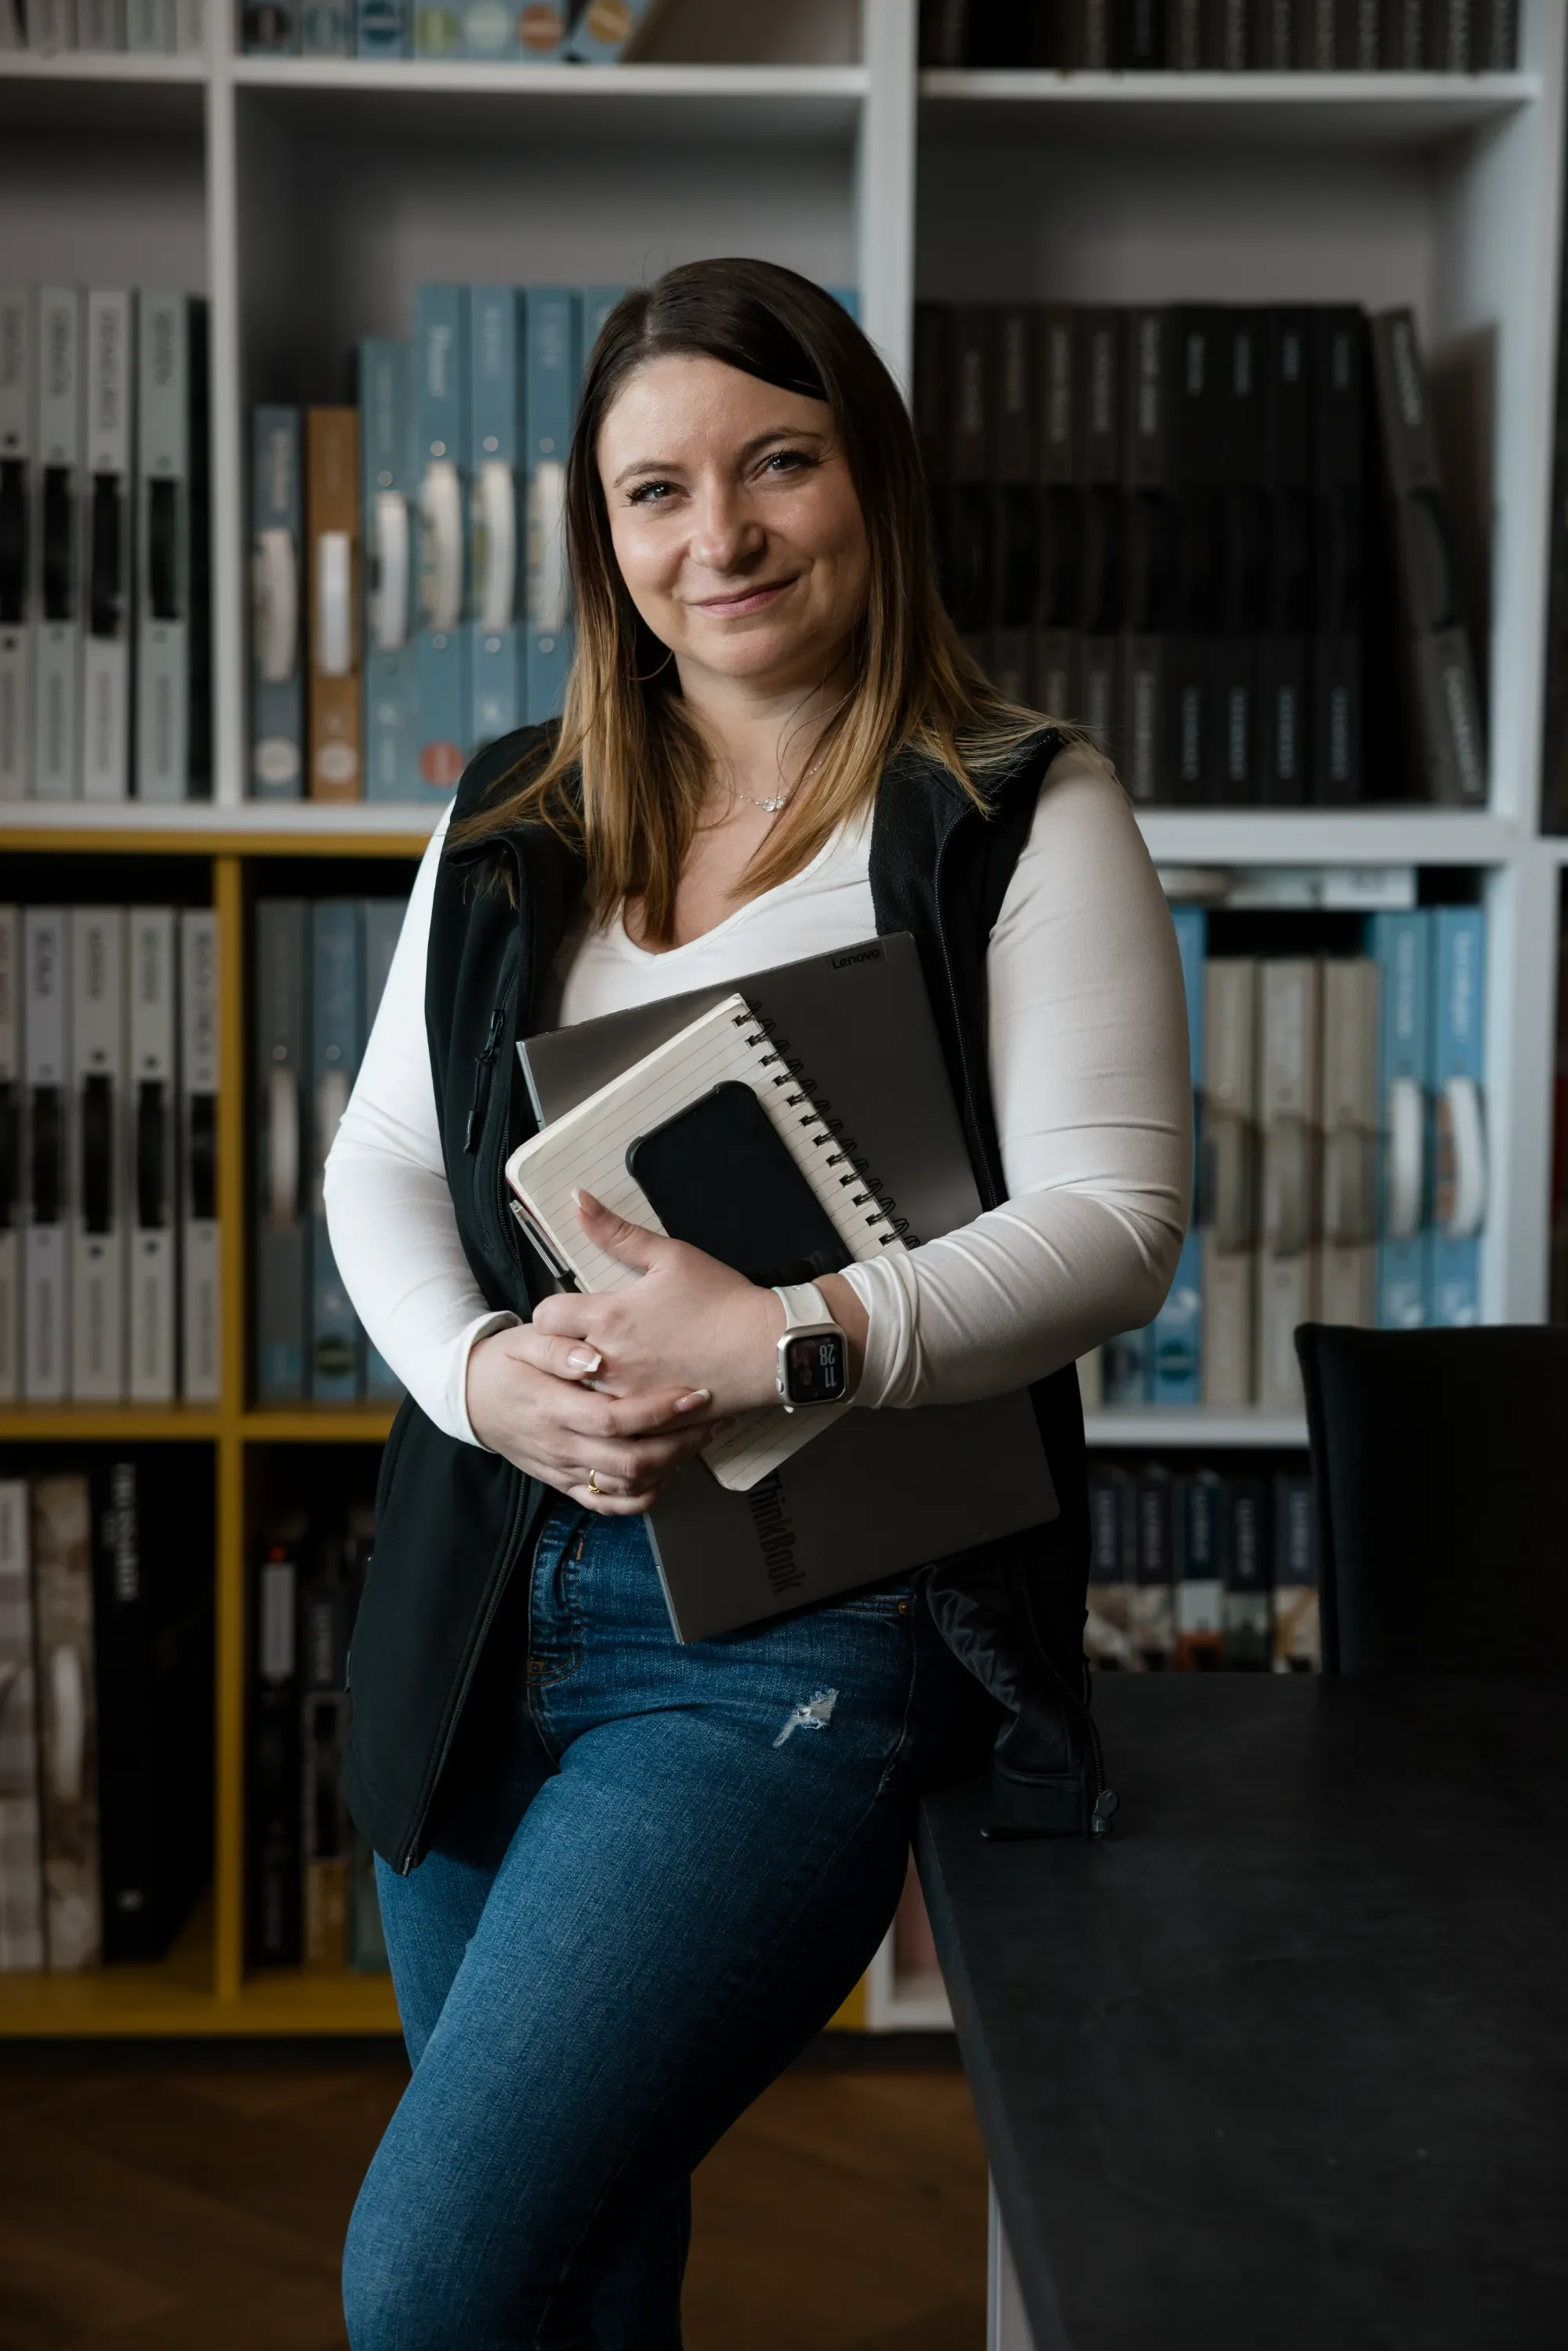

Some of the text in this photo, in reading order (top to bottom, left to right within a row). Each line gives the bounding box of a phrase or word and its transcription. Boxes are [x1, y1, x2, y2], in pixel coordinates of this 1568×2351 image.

[832, 949, 880, 970] Lenovo
[818, 1343, 837, 1366] 28
[824, 1366, 837, 1388] 11
